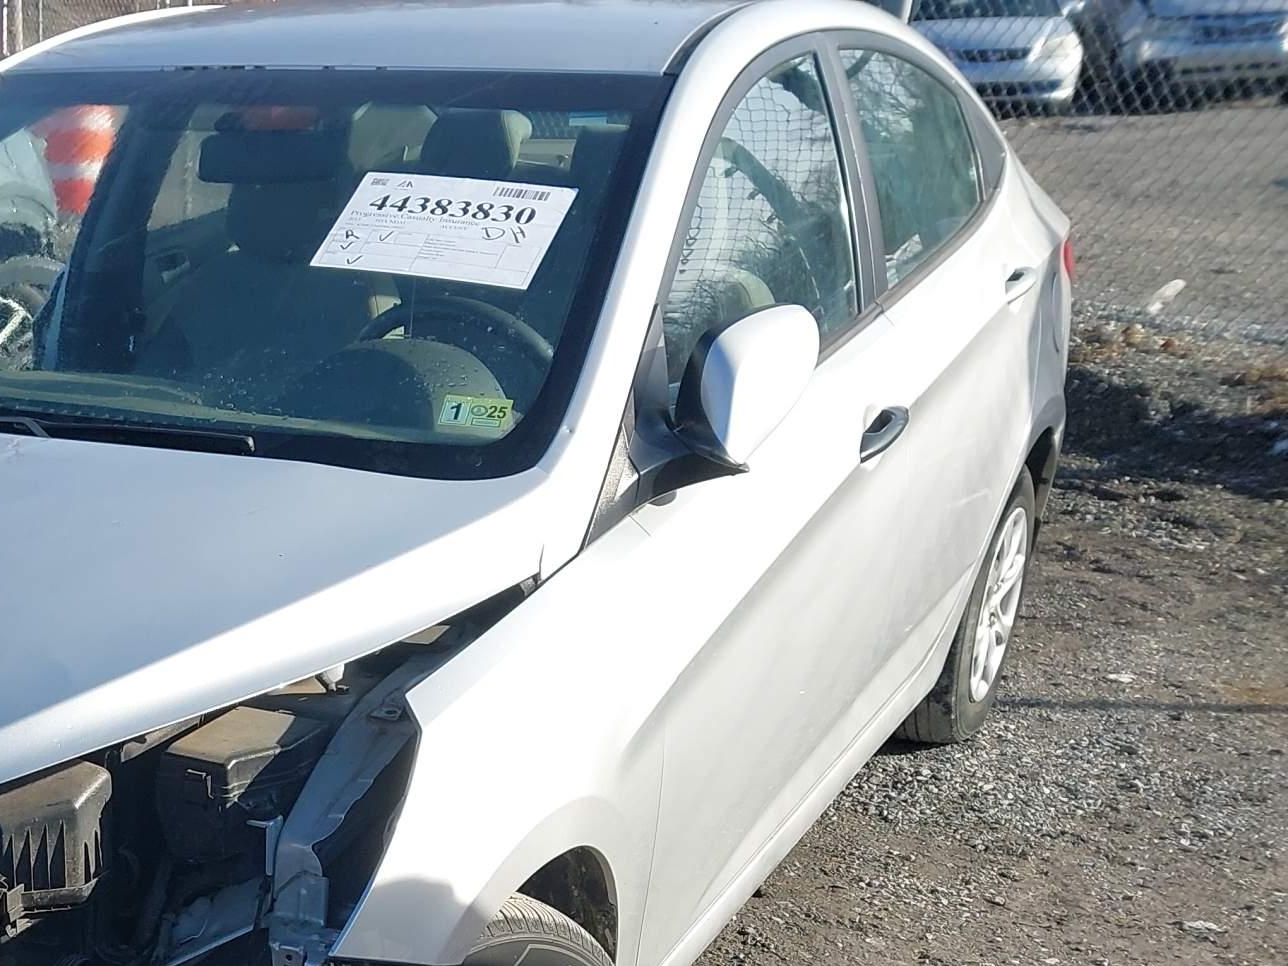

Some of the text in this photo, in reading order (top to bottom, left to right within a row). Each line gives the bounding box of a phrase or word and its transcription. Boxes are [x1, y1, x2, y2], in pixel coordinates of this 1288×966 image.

[369, 194, 537, 225] 44383830
[450, 403, 463, 420] 1
[486, 405, 508, 419] 25
